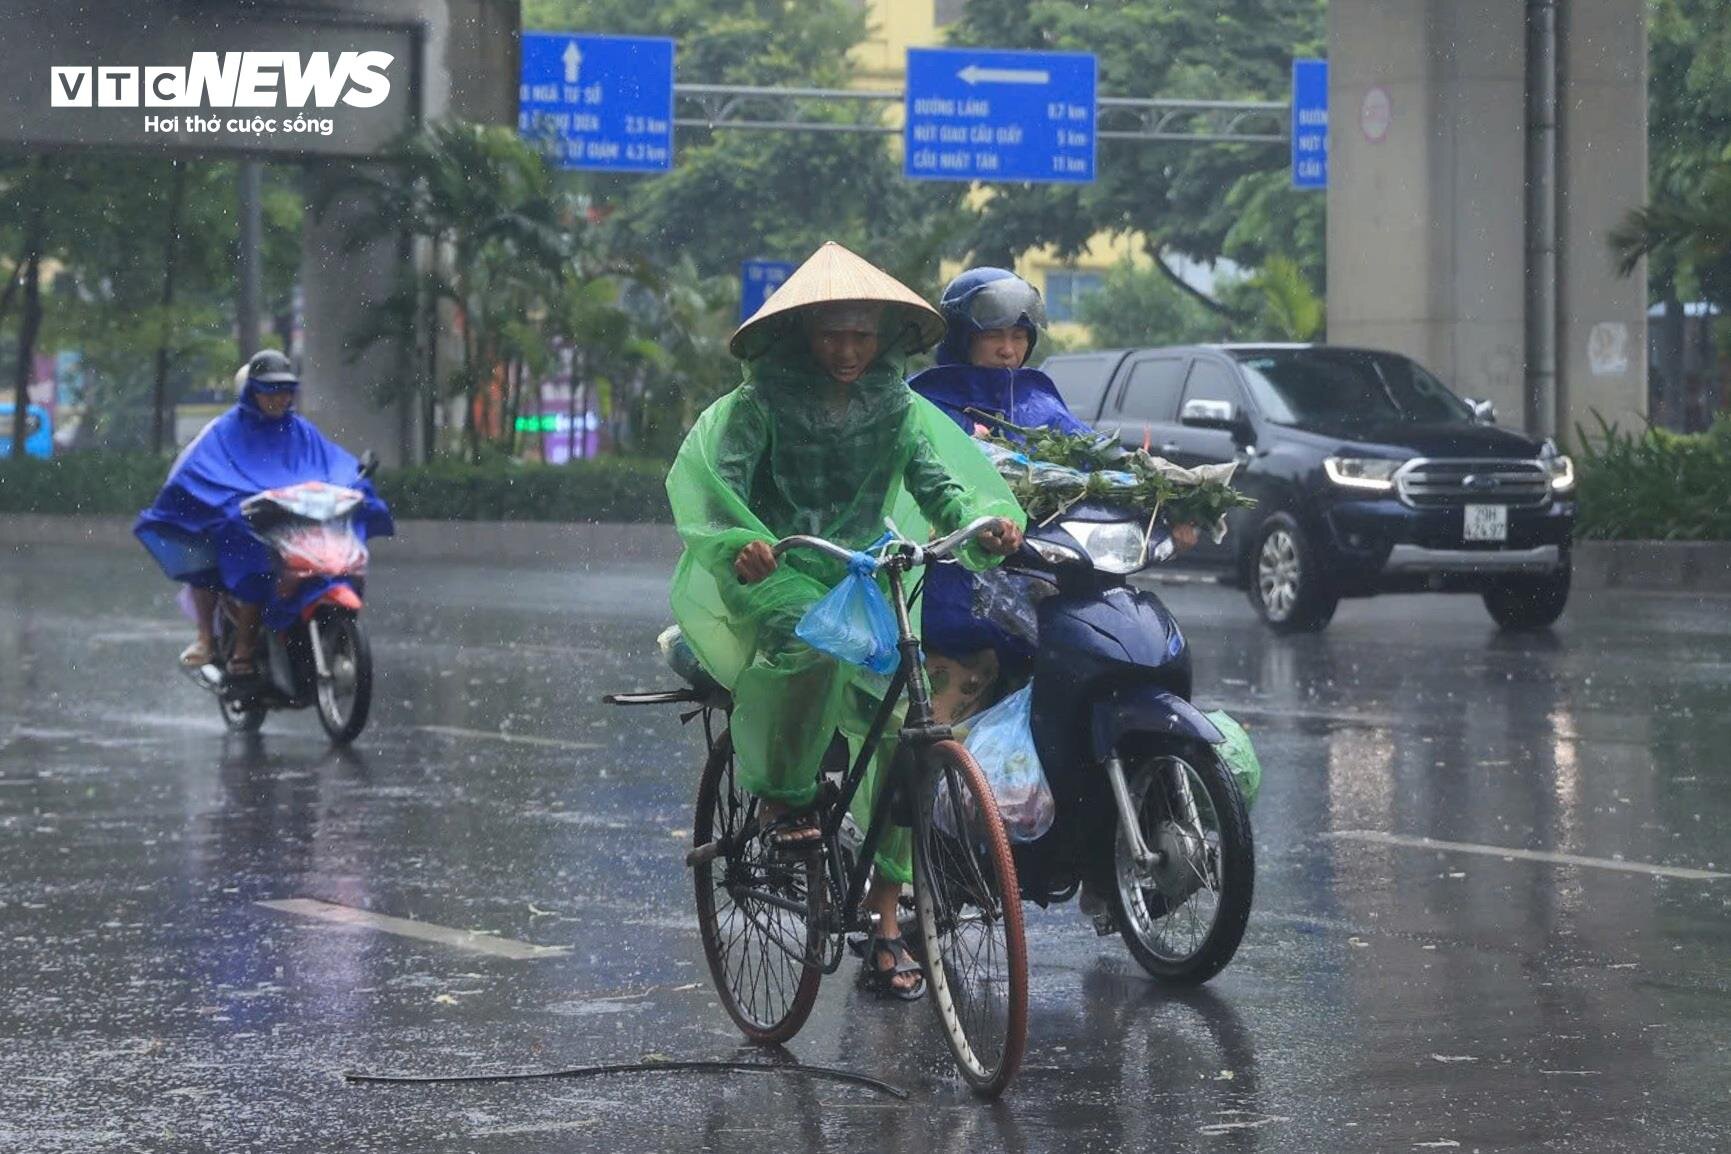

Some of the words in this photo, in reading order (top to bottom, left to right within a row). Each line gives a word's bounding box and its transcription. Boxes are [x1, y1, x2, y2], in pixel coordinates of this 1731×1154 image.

[1068, 103, 1087, 120] km
[646, 116, 667, 134] km
[1068, 130, 1087, 147] km
[646, 144, 667, 161] km
[1067, 156, 1087, 173] km
